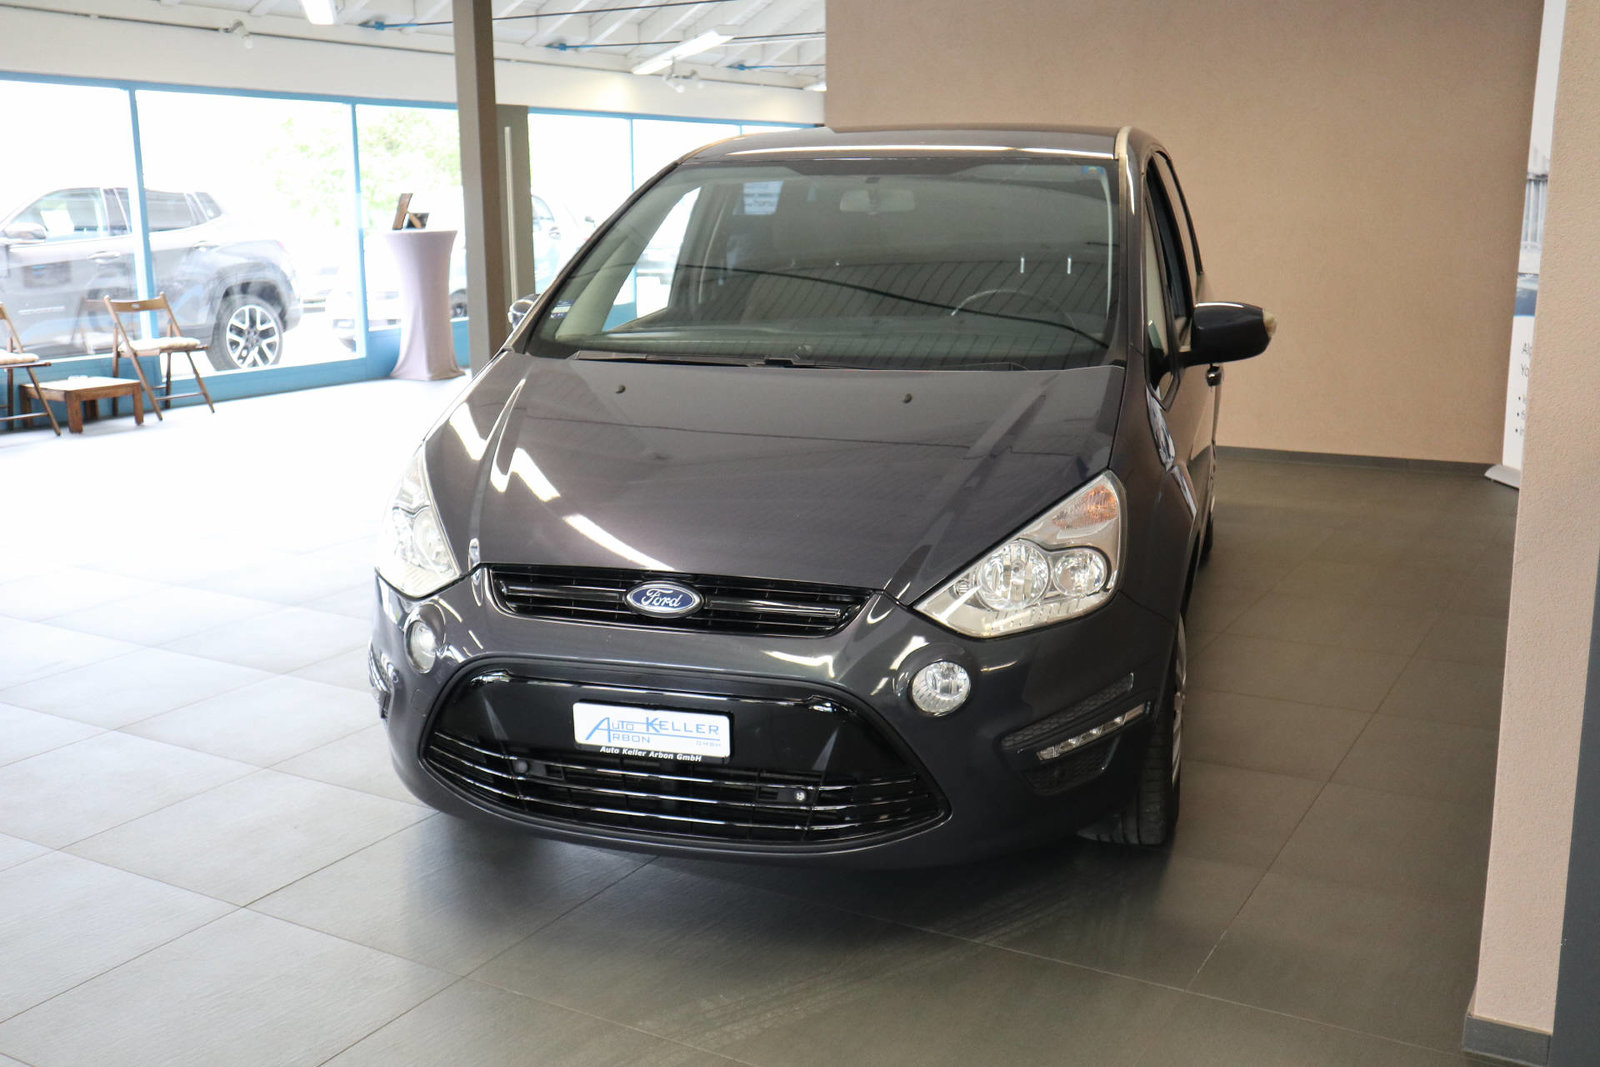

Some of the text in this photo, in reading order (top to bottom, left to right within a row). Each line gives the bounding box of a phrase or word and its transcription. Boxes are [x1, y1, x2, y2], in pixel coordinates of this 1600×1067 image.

[641, 588, 683, 607] Ford
[646, 717, 719, 735] KELLER
[600, 746, 702, 762] Auto Keller Arbon GmbH
